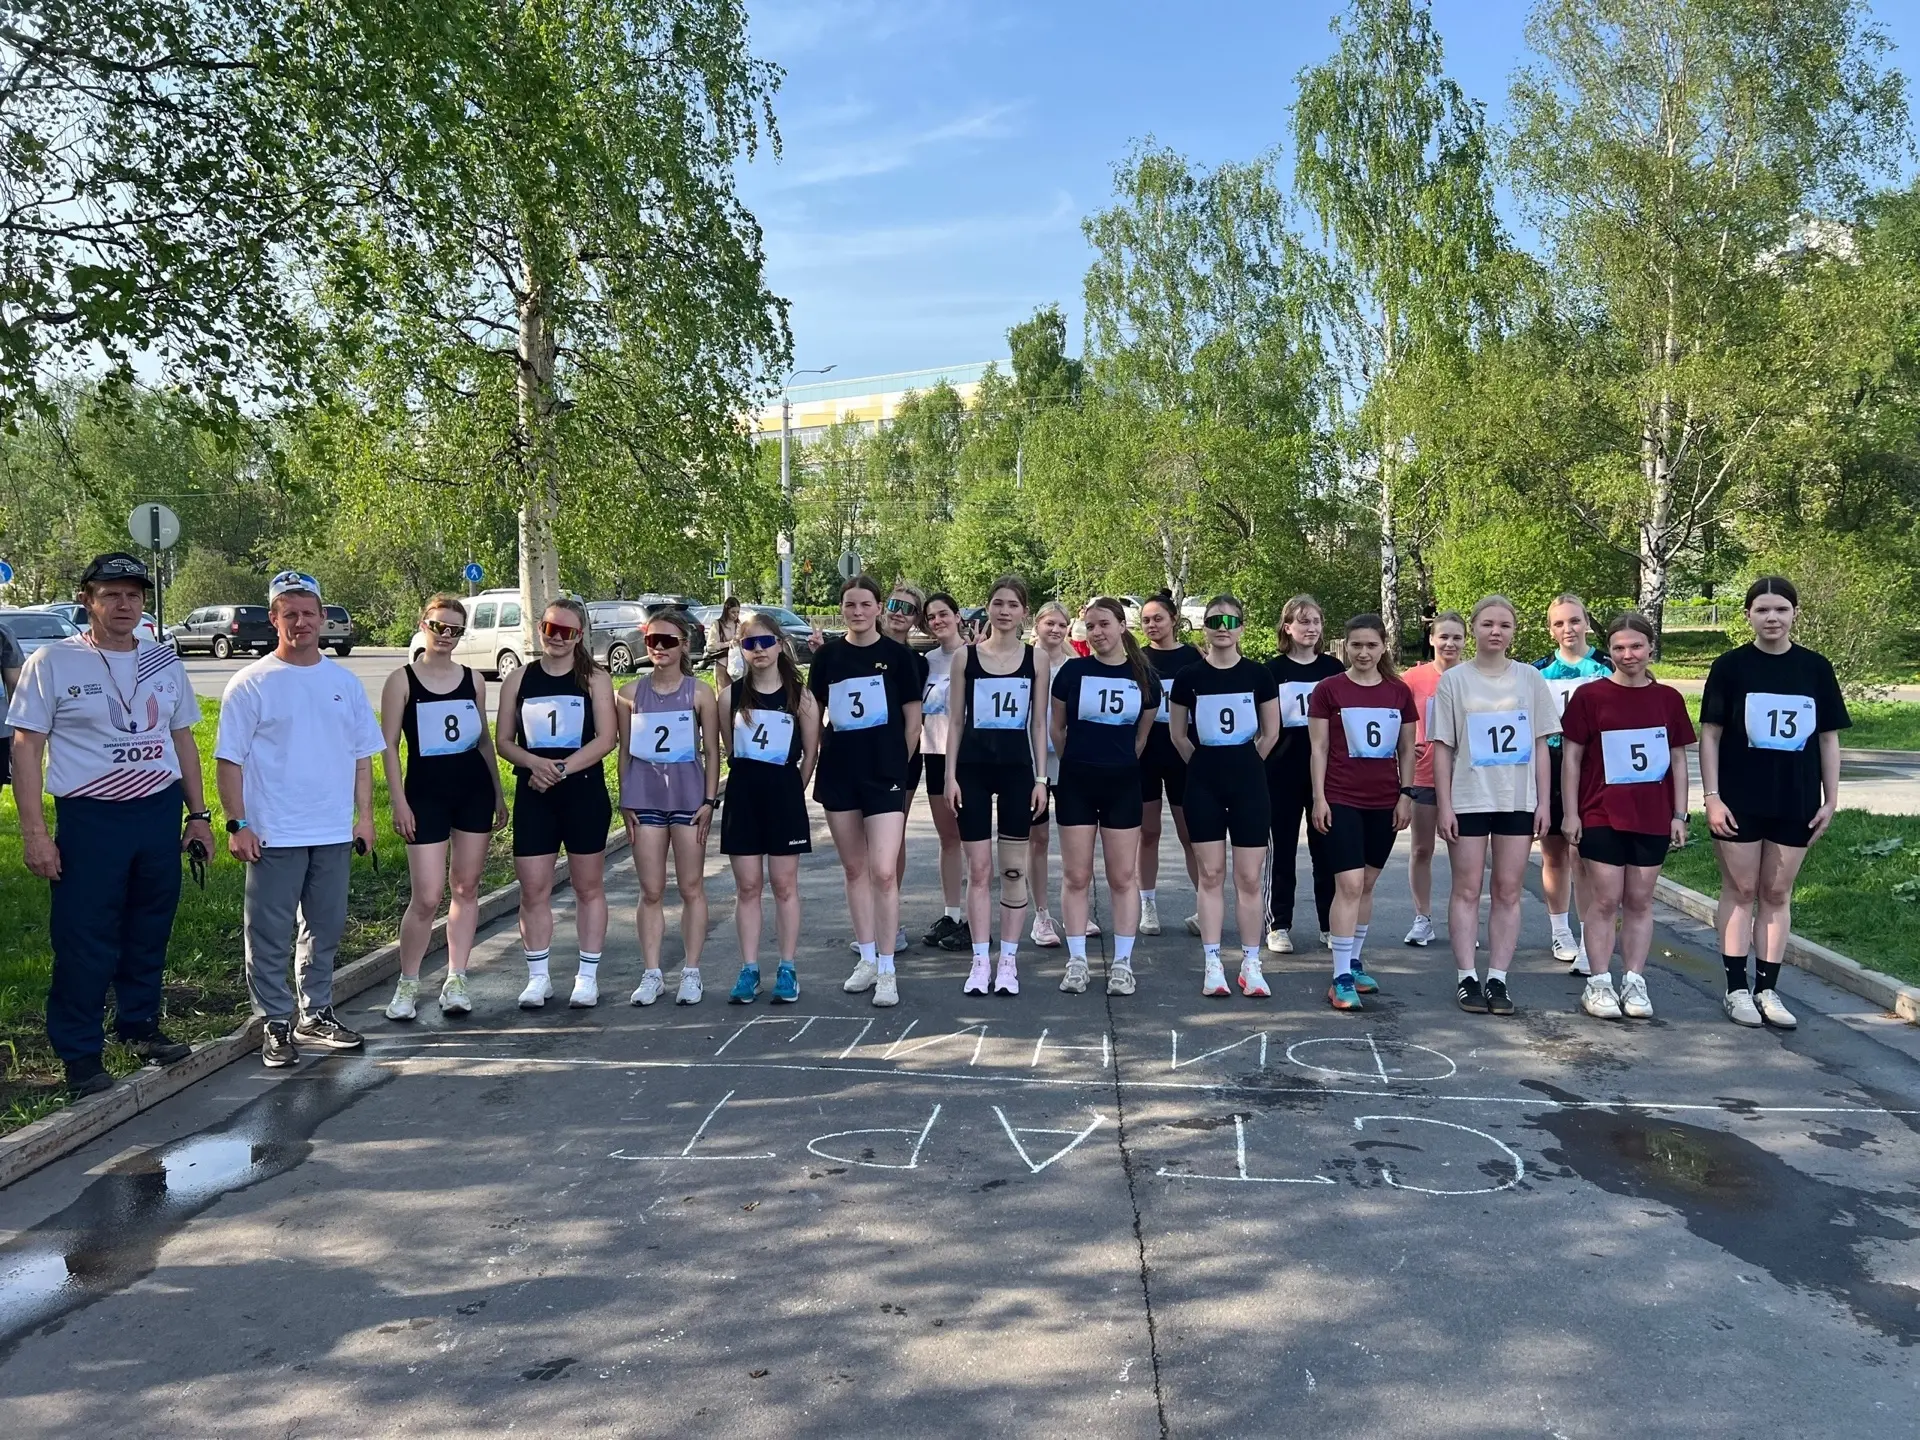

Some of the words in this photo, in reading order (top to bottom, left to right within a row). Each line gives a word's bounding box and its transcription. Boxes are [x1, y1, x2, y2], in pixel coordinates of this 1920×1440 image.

[847, 691, 865, 719] 3
[991, 691, 1019, 718] 14
[1098, 688, 1124, 715] 15
[444, 714, 460, 743] 8
[547, 709, 557, 737] 1
[1219, 707, 1235, 735] 9
[1366, 720, 1381, 748] 6
[1769, 709, 1798, 739] 13
[654, 725, 671, 754] 2
[751, 723, 769, 750] 4
[1487, 724, 1518, 754] 12
[112, 745, 163, 763] 2022
[1630, 743, 1648, 772] 5
[714, 1014, 1457, 1084] ФИНИШ
[607, 1089, 1526, 1195] СТАРТ
